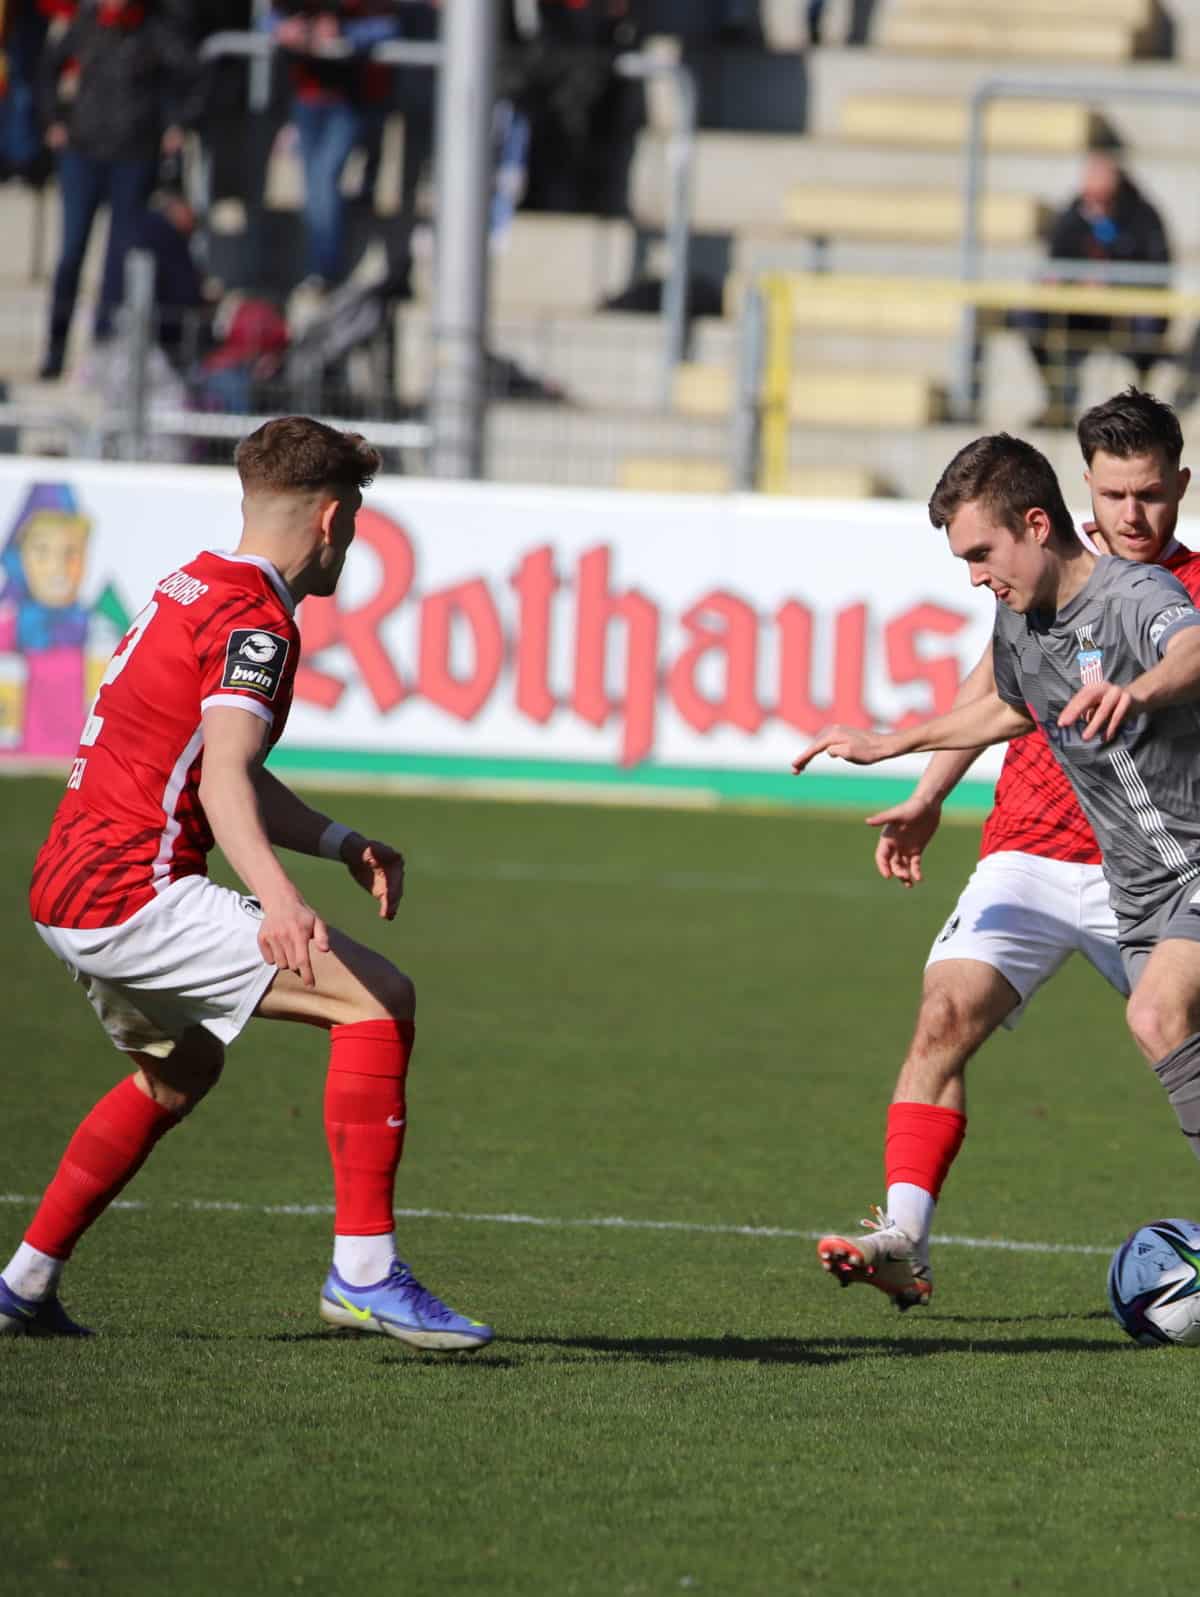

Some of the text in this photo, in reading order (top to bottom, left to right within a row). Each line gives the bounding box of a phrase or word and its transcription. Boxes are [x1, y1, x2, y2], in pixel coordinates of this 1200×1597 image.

[157, 570, 209, 605] IBURG
[296, 506, 970, 772] Rothaus
[230, 665, 273, 687] bwin
